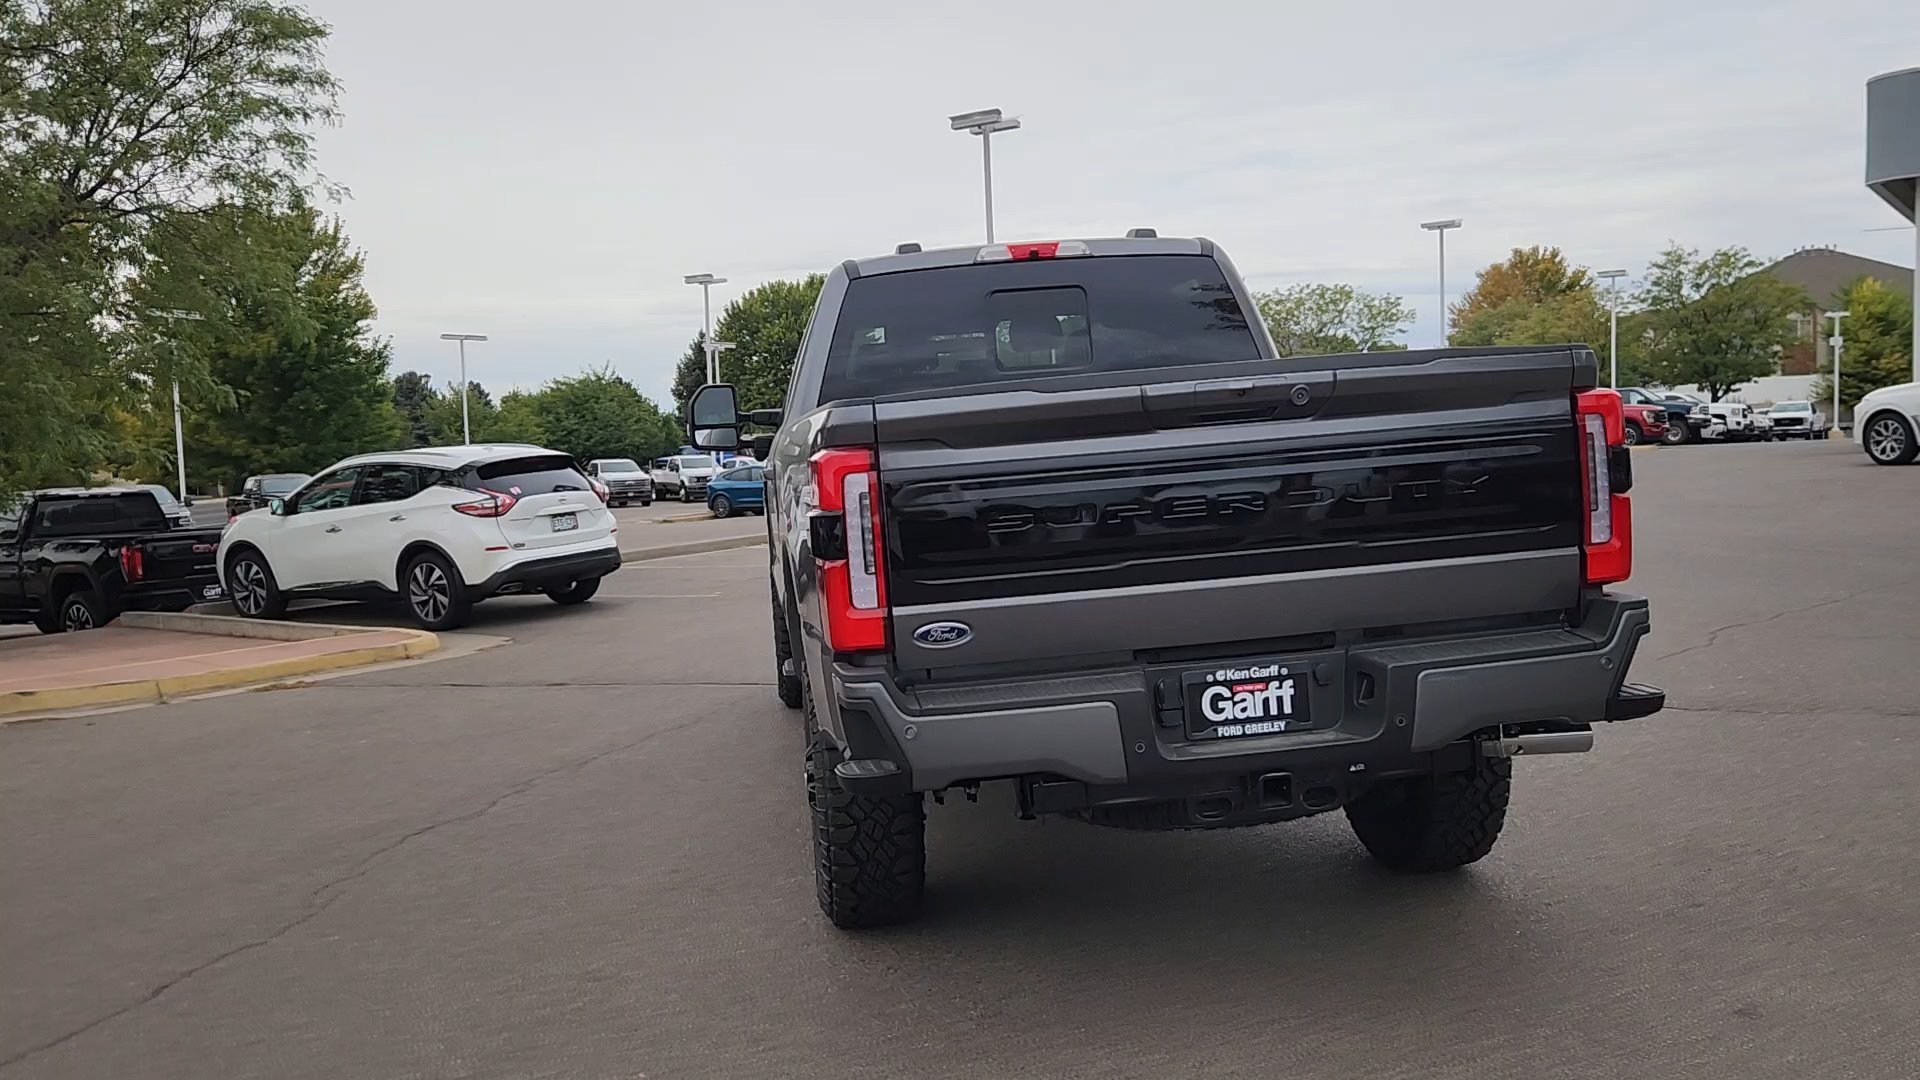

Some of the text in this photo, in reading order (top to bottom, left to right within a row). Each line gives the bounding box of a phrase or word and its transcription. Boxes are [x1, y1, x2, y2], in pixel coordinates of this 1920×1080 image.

[985, 474, 1490, 534] SUPER DUTY
[192, 543, 219, 553] GM
[927, 627, 958, 641] Ford
[1226, 665, 1278, 681] Ken Garff
[1201, 679, 1295, 722] Garff
[1217, 721, 1286, 737] FORD GREELEY
